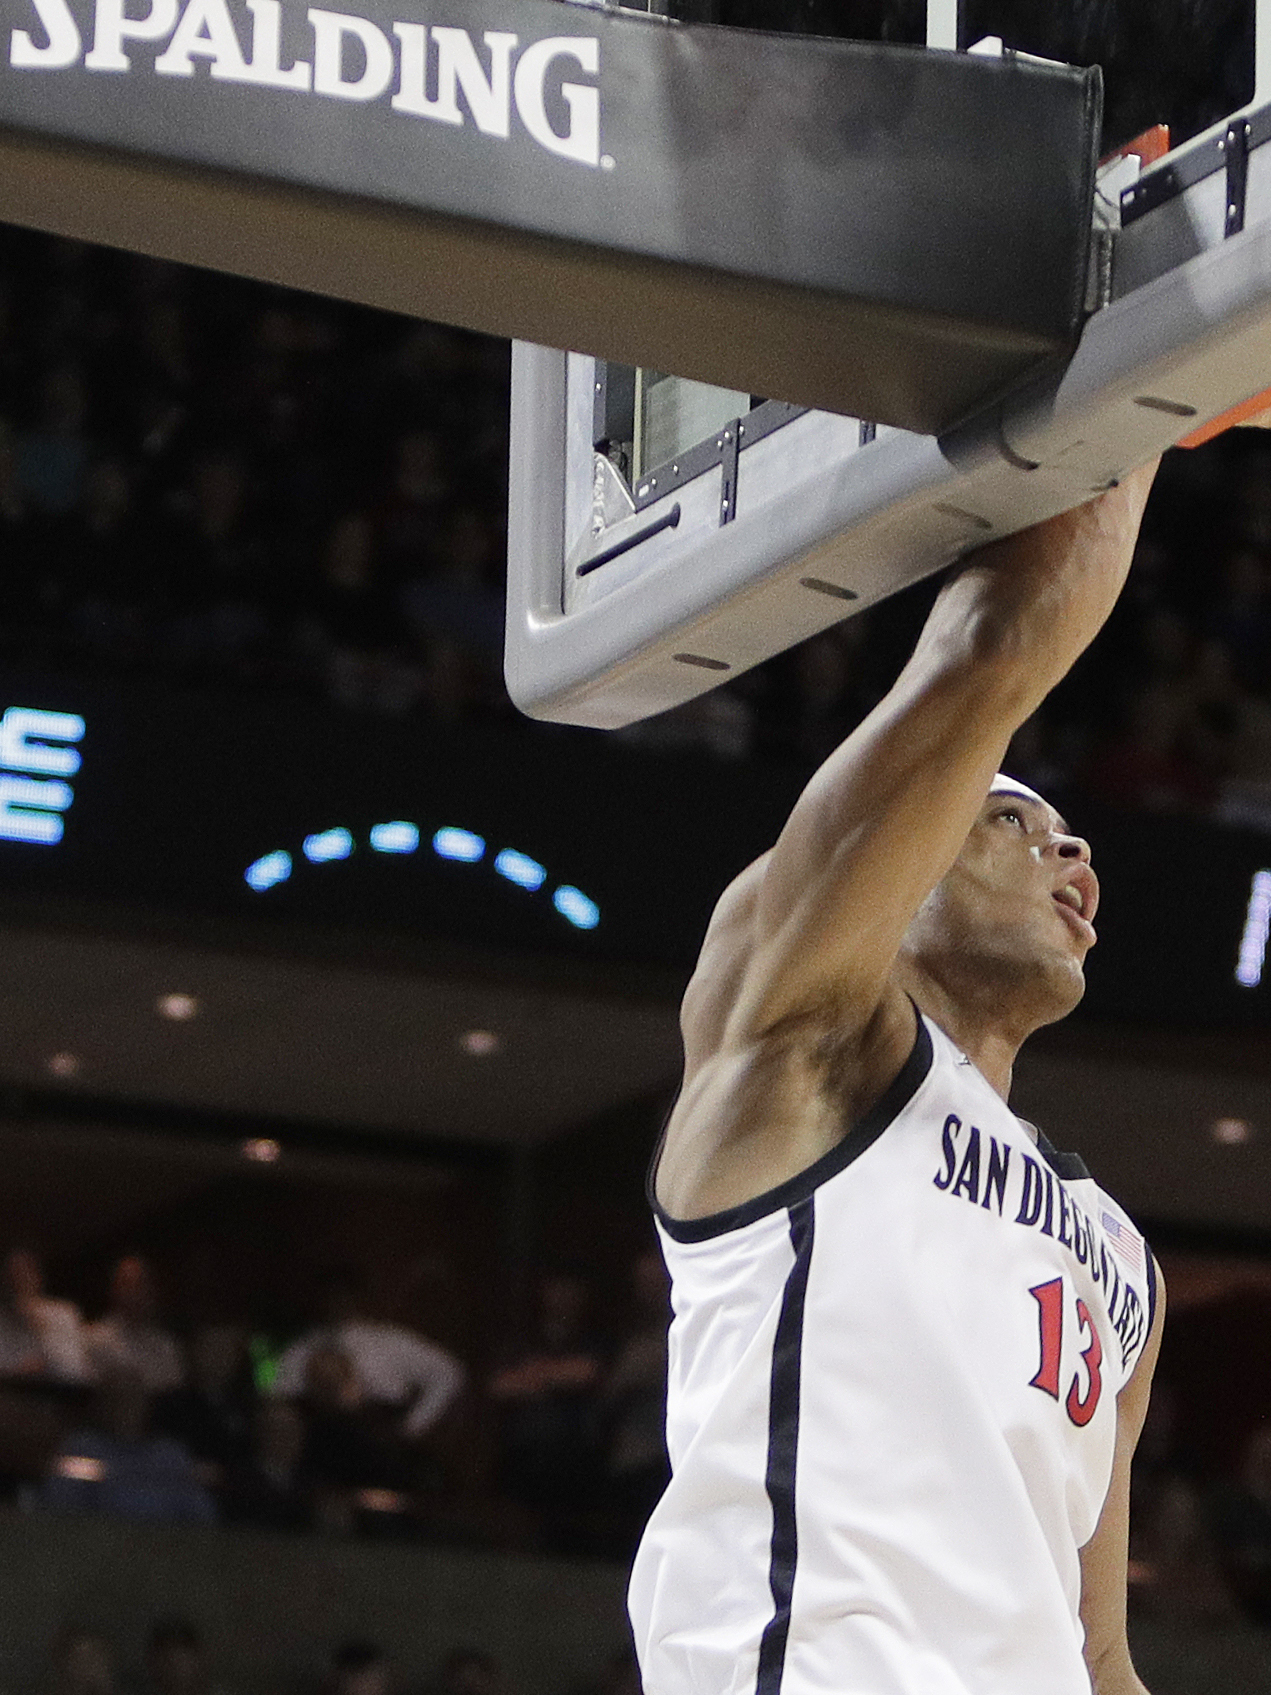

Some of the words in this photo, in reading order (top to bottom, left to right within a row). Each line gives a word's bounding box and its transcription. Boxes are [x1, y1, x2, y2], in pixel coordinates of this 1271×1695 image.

[10, 0, 602, 168] SPALDING
[933, 1113, 1012, 1217] SAN
[1014, 1152, 1100, 1283] DIEGO
[1028, 1275, 1102, 1427] 13
